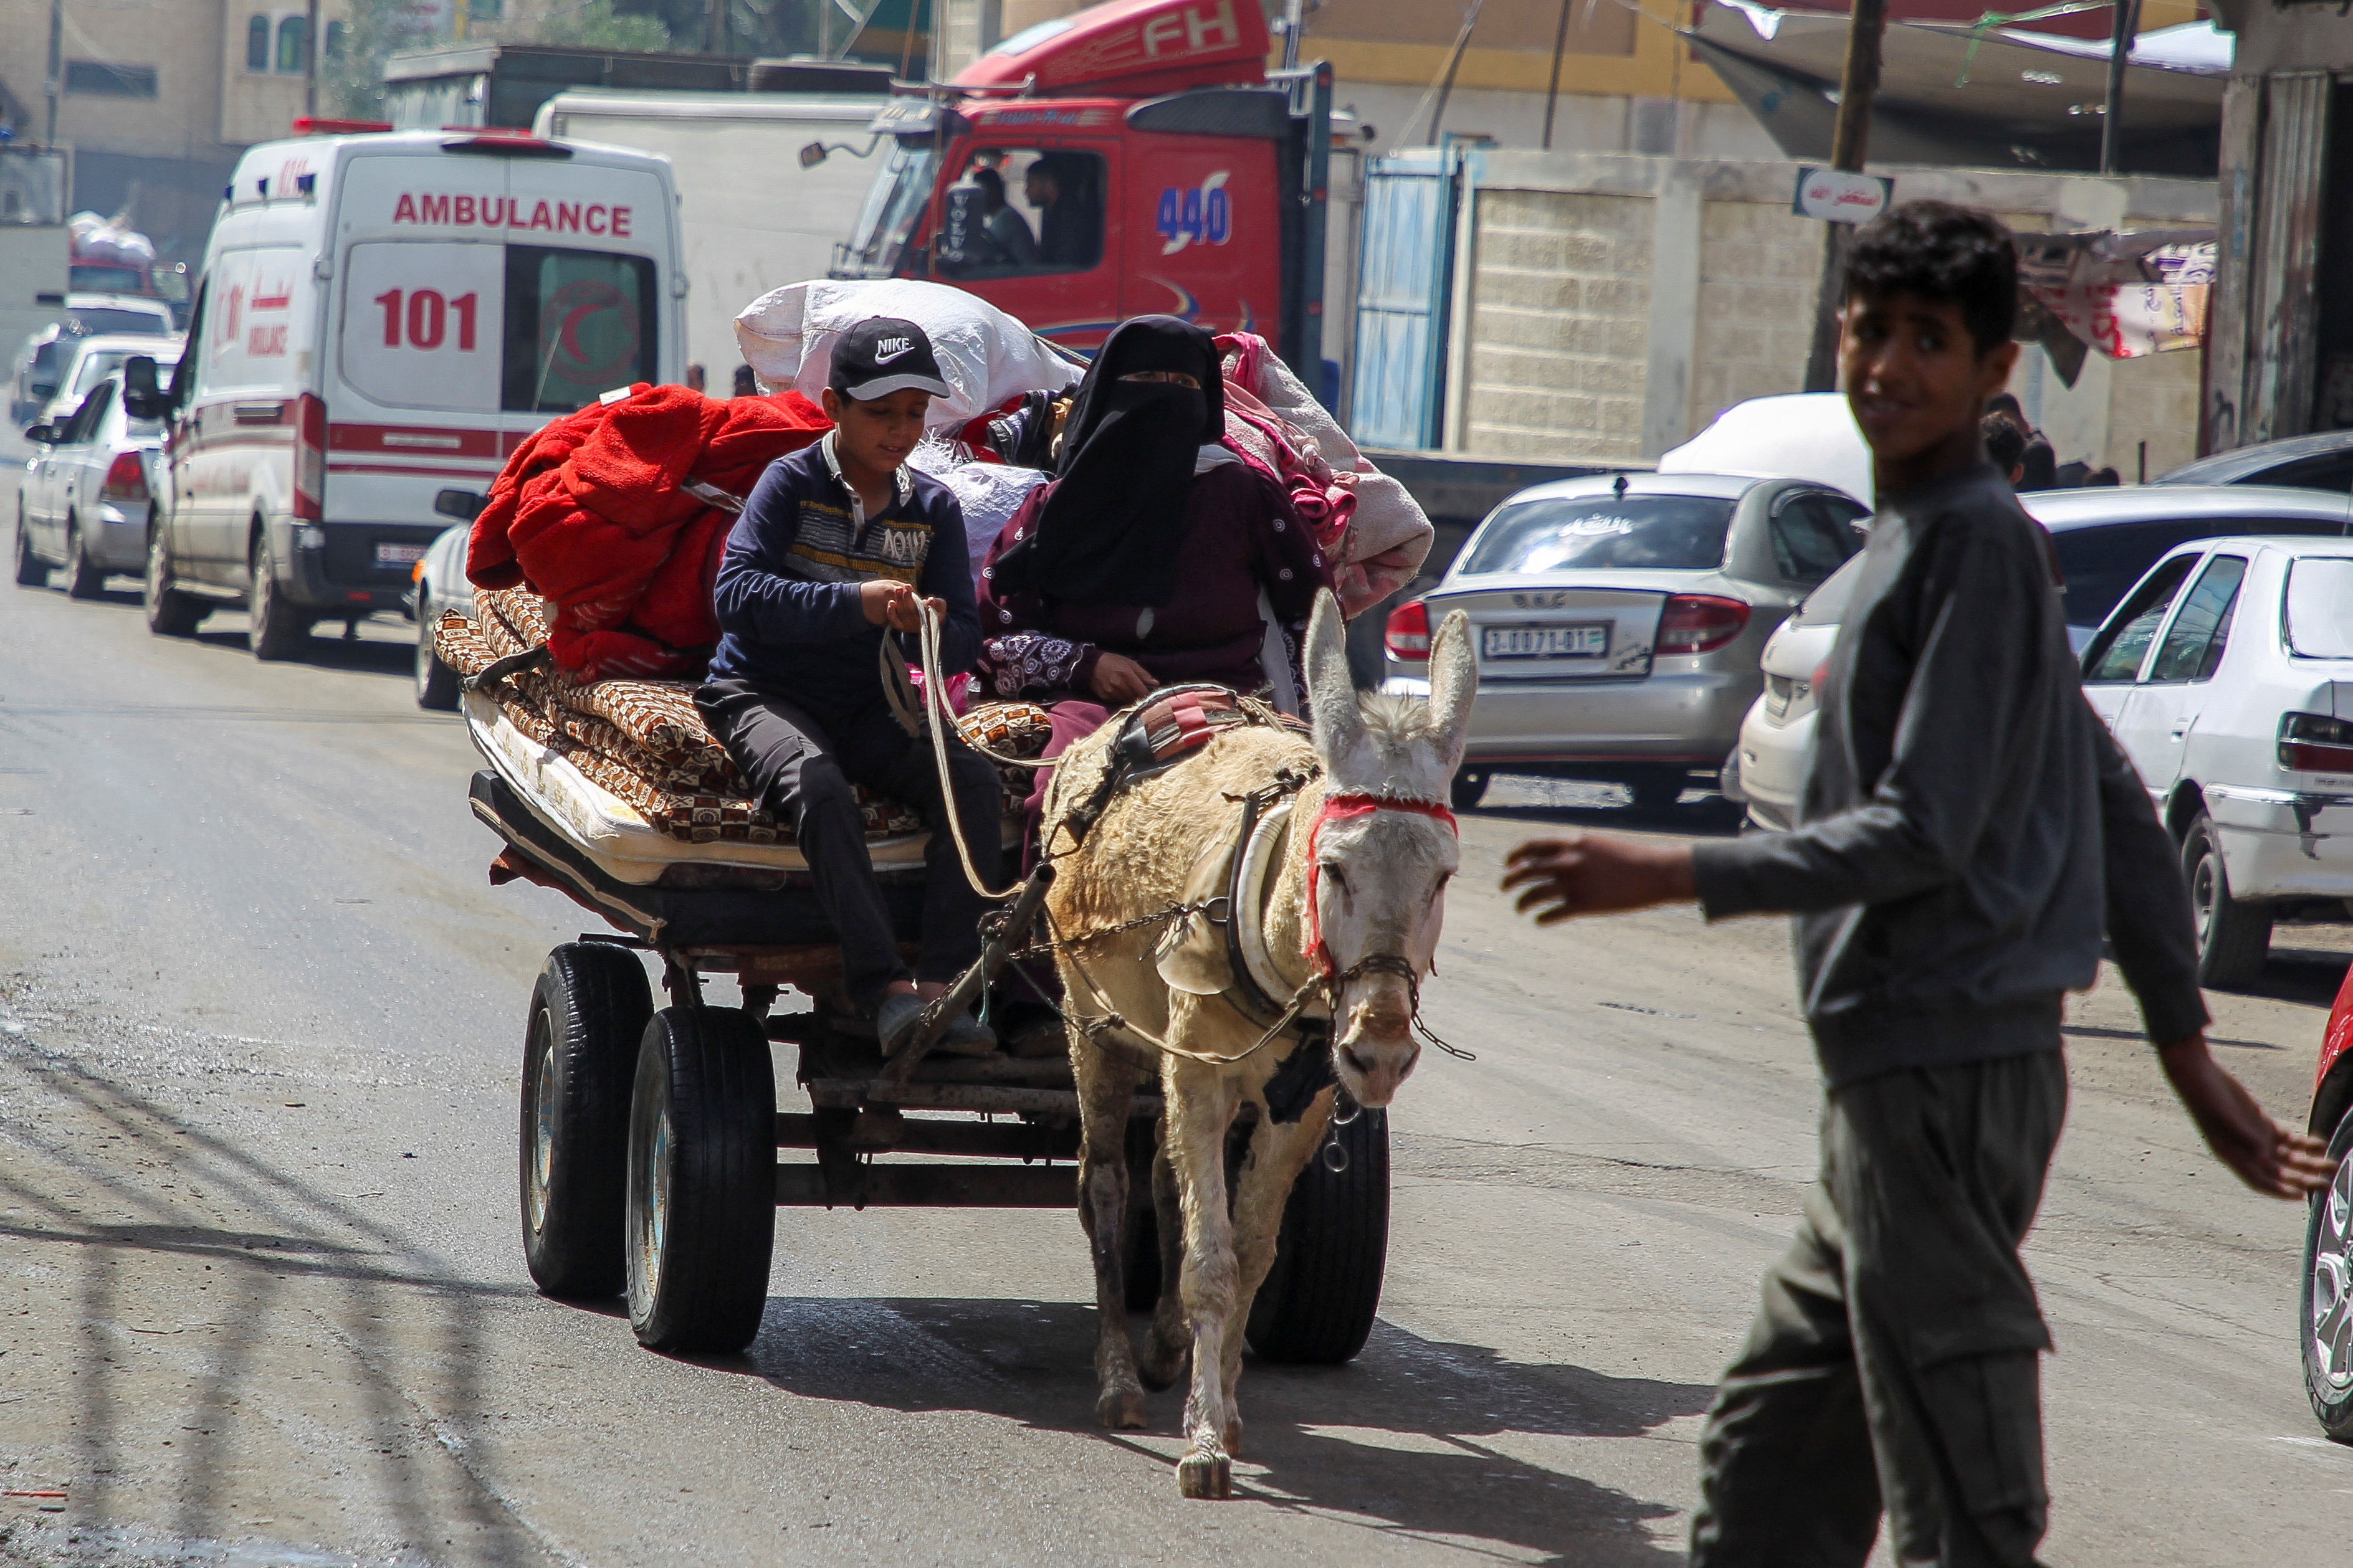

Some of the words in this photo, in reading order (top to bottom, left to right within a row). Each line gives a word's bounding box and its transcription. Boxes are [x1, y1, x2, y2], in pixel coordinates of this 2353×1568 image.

[1143, 0, 1240, 57] FH
[394, 193, 631, 237] AMBULANCE
[948, 194, 970, 262] VOLVO
[1157, 187, 1232, 245] 440
[374, 289, 477, 352] 101
[877, 337, 910, 354] NIKE
